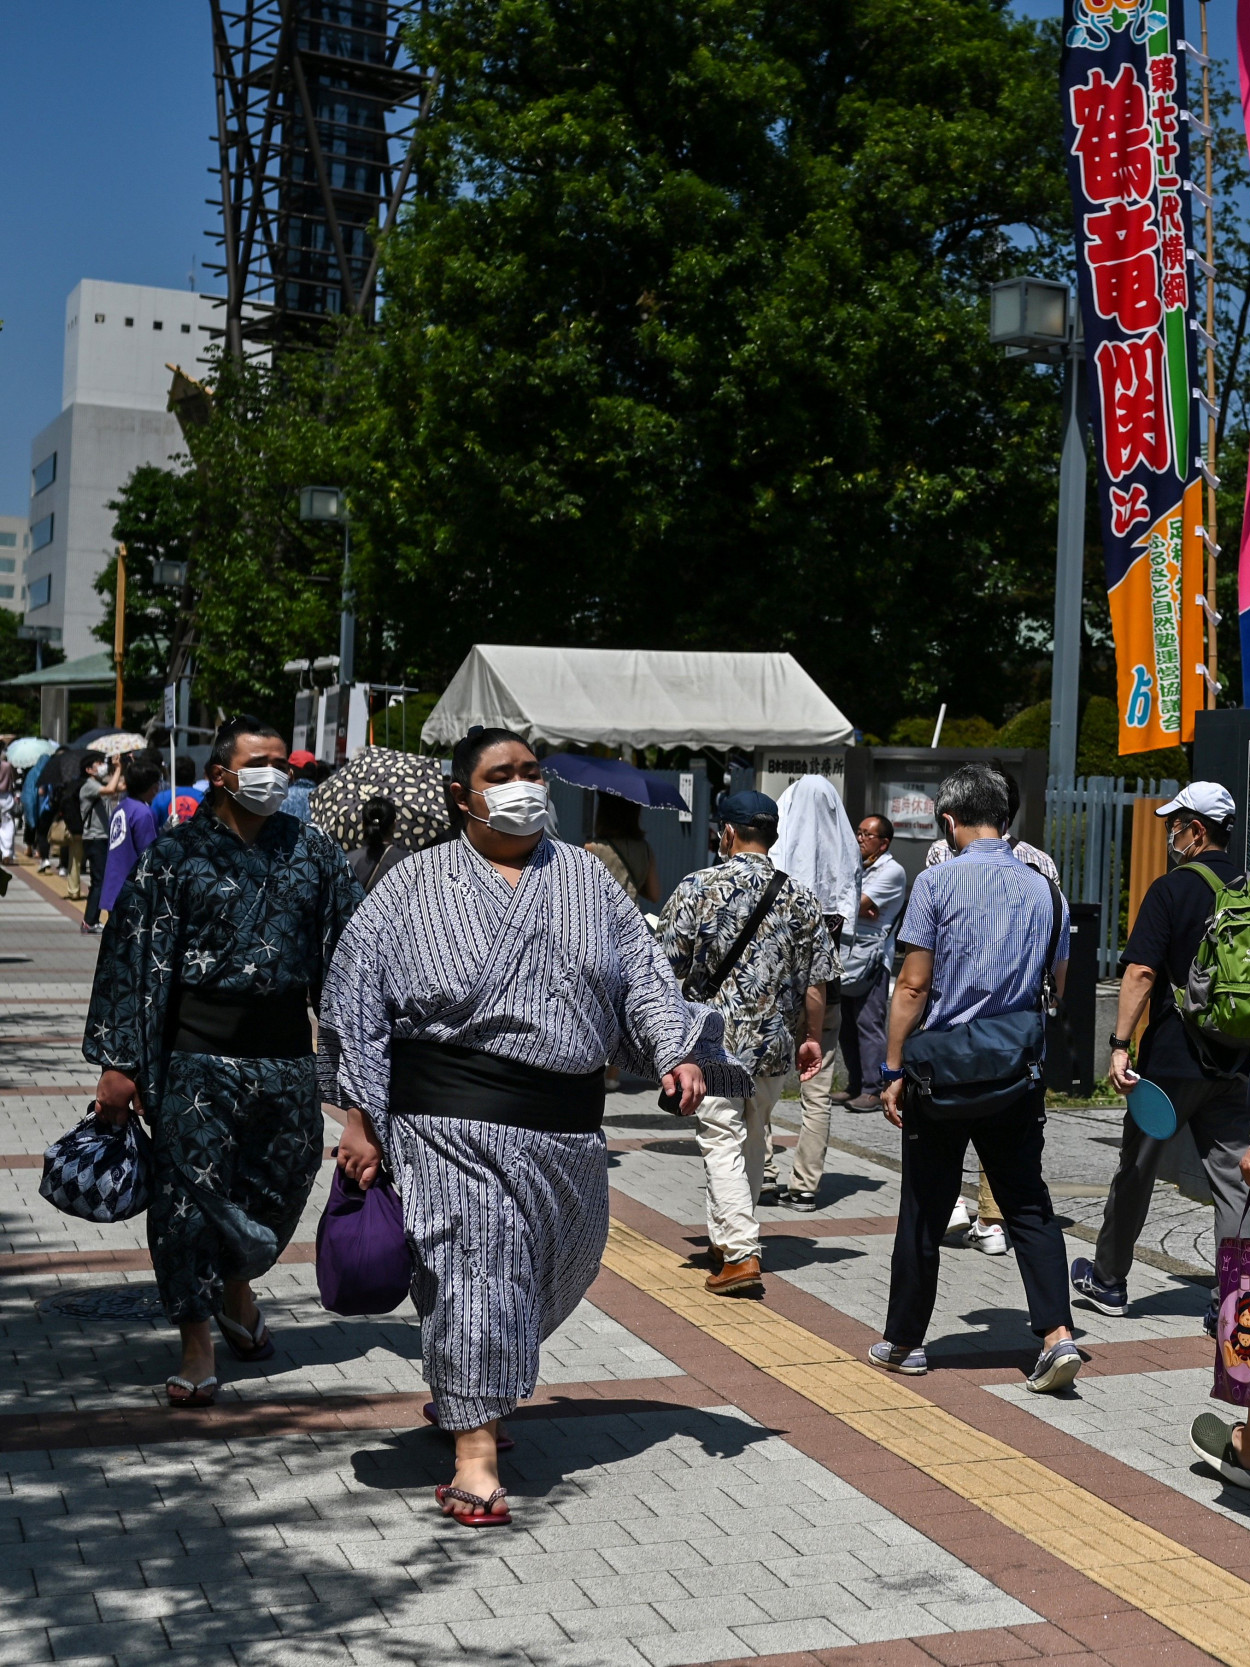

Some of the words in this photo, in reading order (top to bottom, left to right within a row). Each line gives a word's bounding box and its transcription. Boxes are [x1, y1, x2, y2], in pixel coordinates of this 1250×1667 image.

[1147, 53, 1188, 312] 第七十一代横綱
